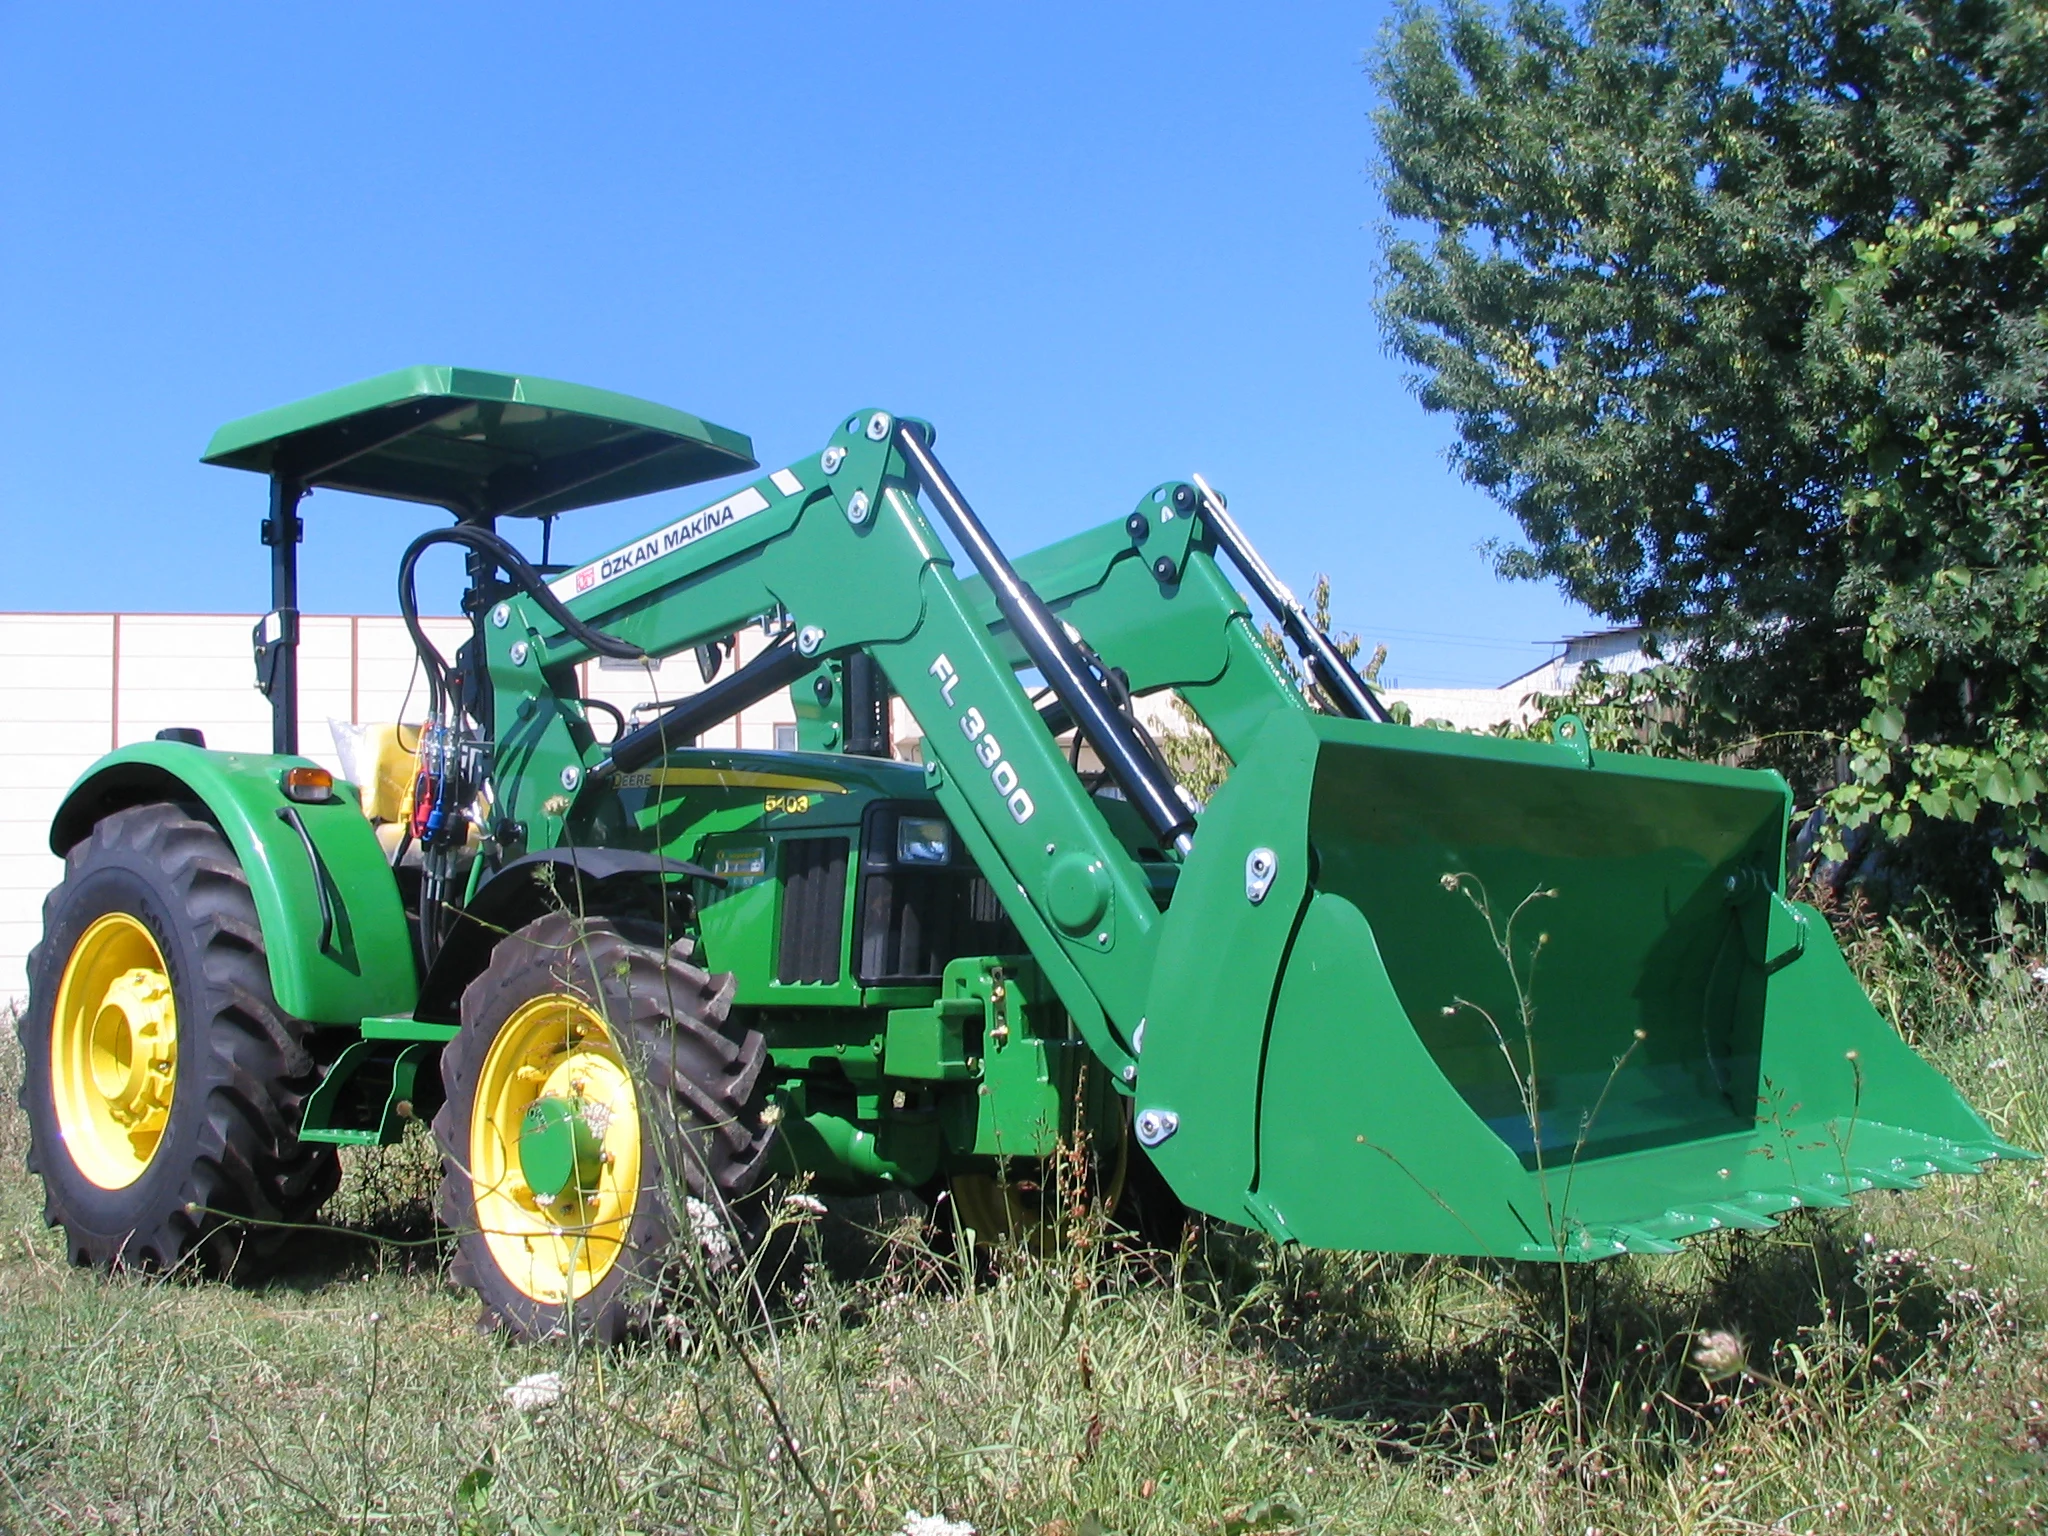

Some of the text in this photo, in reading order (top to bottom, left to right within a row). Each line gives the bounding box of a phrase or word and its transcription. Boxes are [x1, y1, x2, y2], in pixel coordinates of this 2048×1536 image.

[601, 539, 659, 580] ÖZKAN
[664, 505, 734, 550] MAKİNA
[928, 653, 1036, 826] FL 3300
[613, 772, 651, 787] DEERE
[764, 794, 810, 814] 5403
